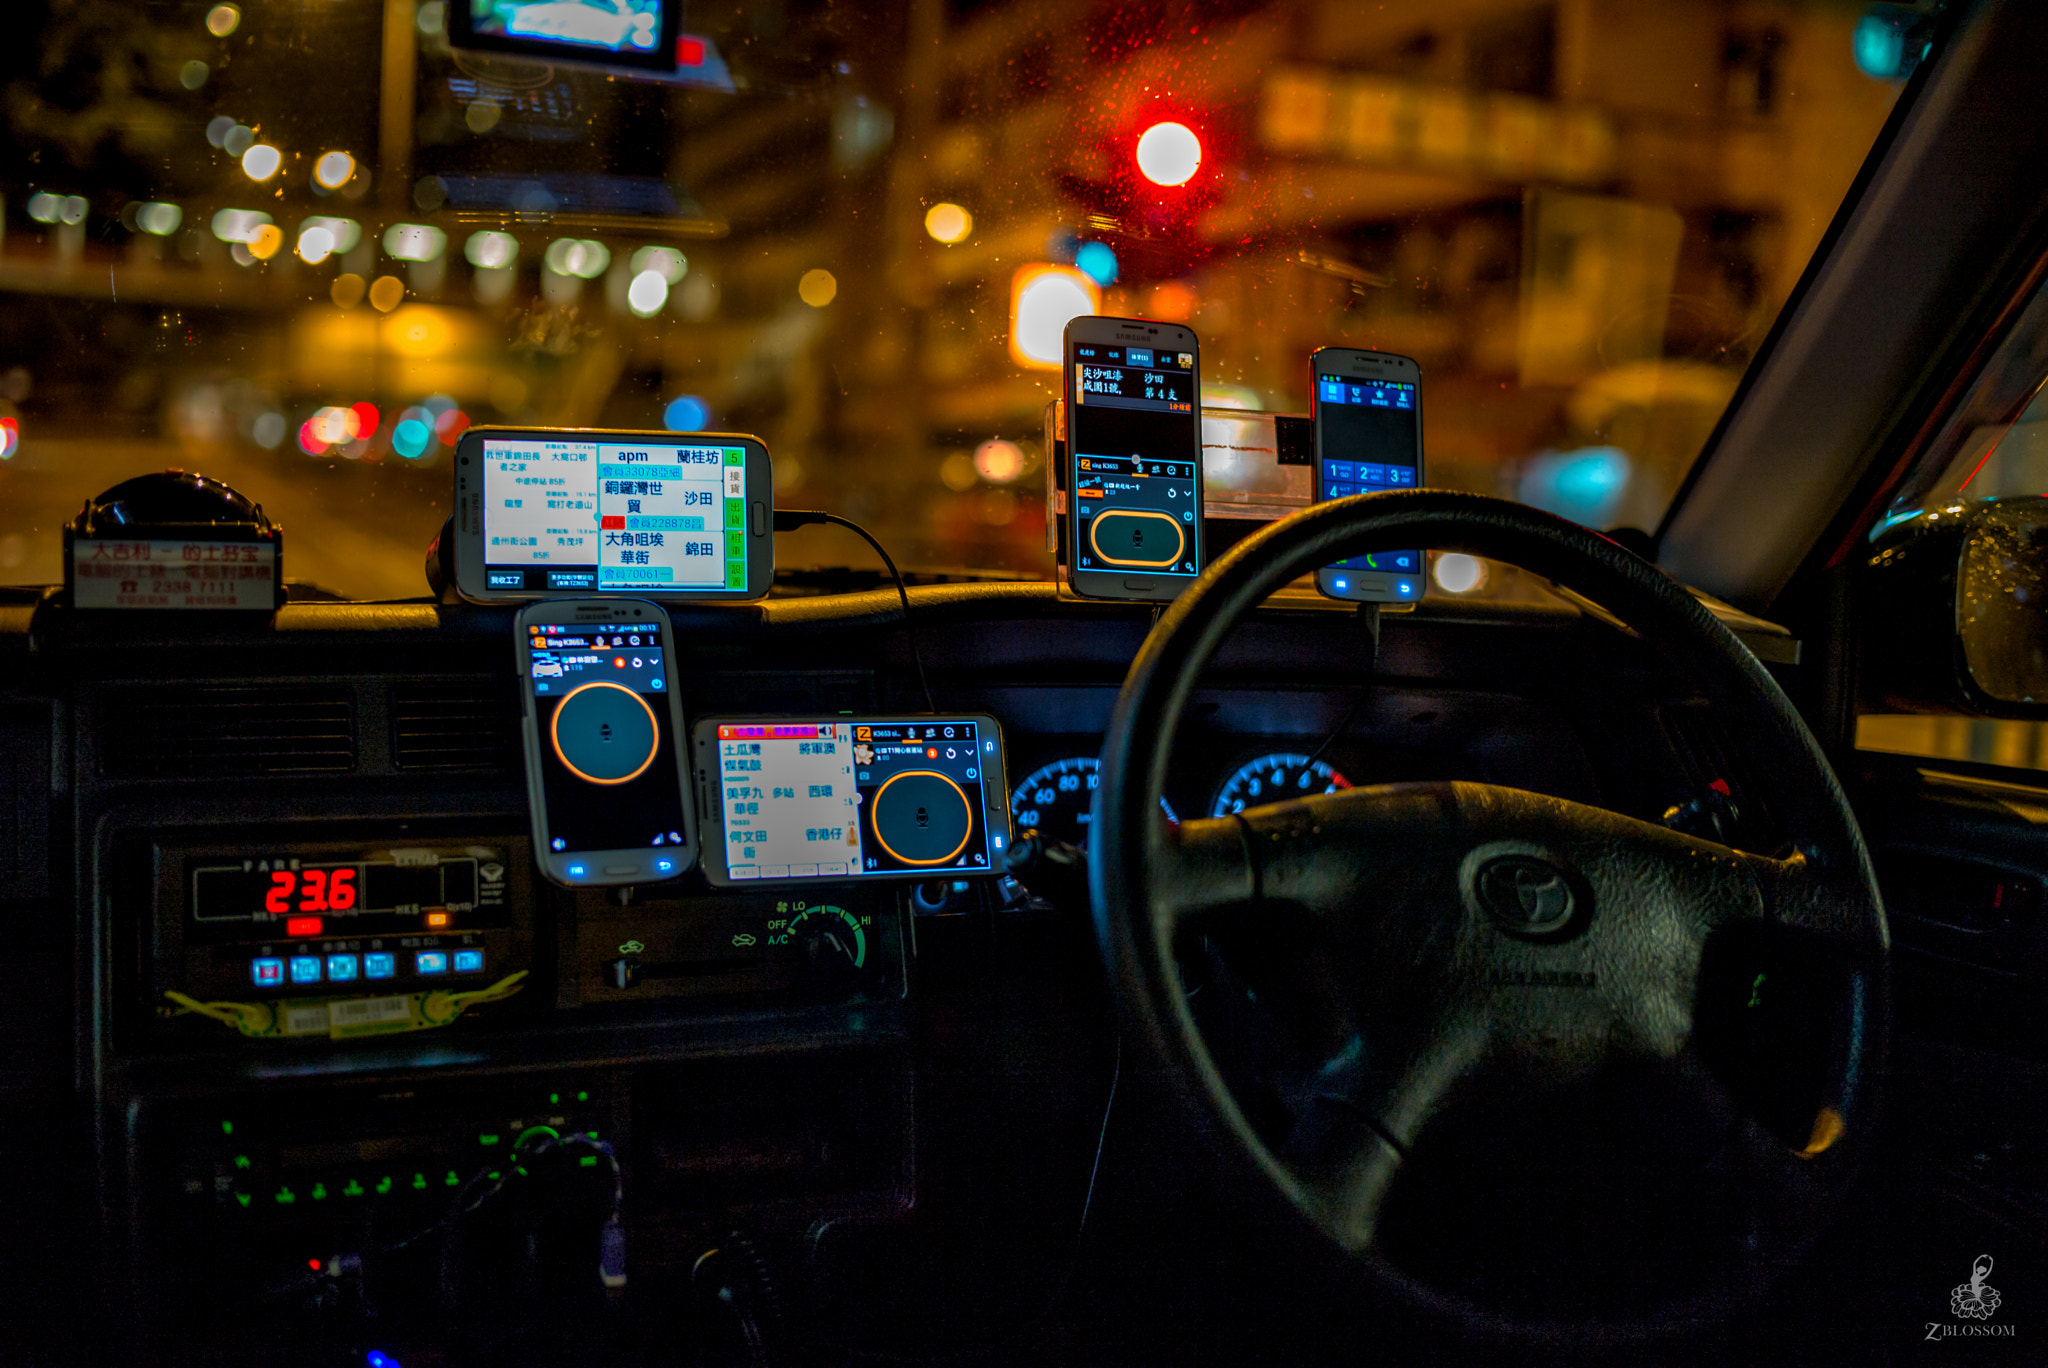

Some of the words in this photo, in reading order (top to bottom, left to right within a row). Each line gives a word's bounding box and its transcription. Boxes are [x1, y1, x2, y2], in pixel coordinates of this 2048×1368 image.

[1144, 373, 1164, 385] 沙田
[618, 451, 648, 464] apm
[676, 449, 720, 465] 蘭桂坊
[731, 453, 738, 463] 5
[1331, 464, 1336, 477] 1
[1360, 467, 1367, 480] 2
[1391, 469, 1398, 483] 3
[605, 480, 663, 495] 銅鑼灣世
[1330, 485, 1338, 498] 4
[684, 491, 713, 506] 沙田
[627, 499, 641, 514] 貿
[605, 532, 664, 547] 大角咀埃
[685, 541, 713, 556] 錦田
[620, 550, 650, 565] 華街
[724, 744, 761, 756] 土瓜灣
[799, 743, 836, 755] 將軍澳
[1059, 775, 1079, 791] 80
[1271, 768, 1284, 786] 4
[727, 787, 764, 799] 美孚九
[808, 785, 833, 798] 西環
[1249, 778, 1262, 796] 3
[1035, 789, 1056, 804] 60
[1232, 799, 1245, 813] 2
[1018, 811, 1039, 826] 40
[730, 831, 767, 843] 何文田
[806, 828, 842, 841] 香港仔
[266, 869, 355, 913] 23.6
[793, 902, 806, 911] LO
[768, 920, 787, 930] OFF
[861, 916, 871, 925] HI
[768, 935, 788, 945] A/C
